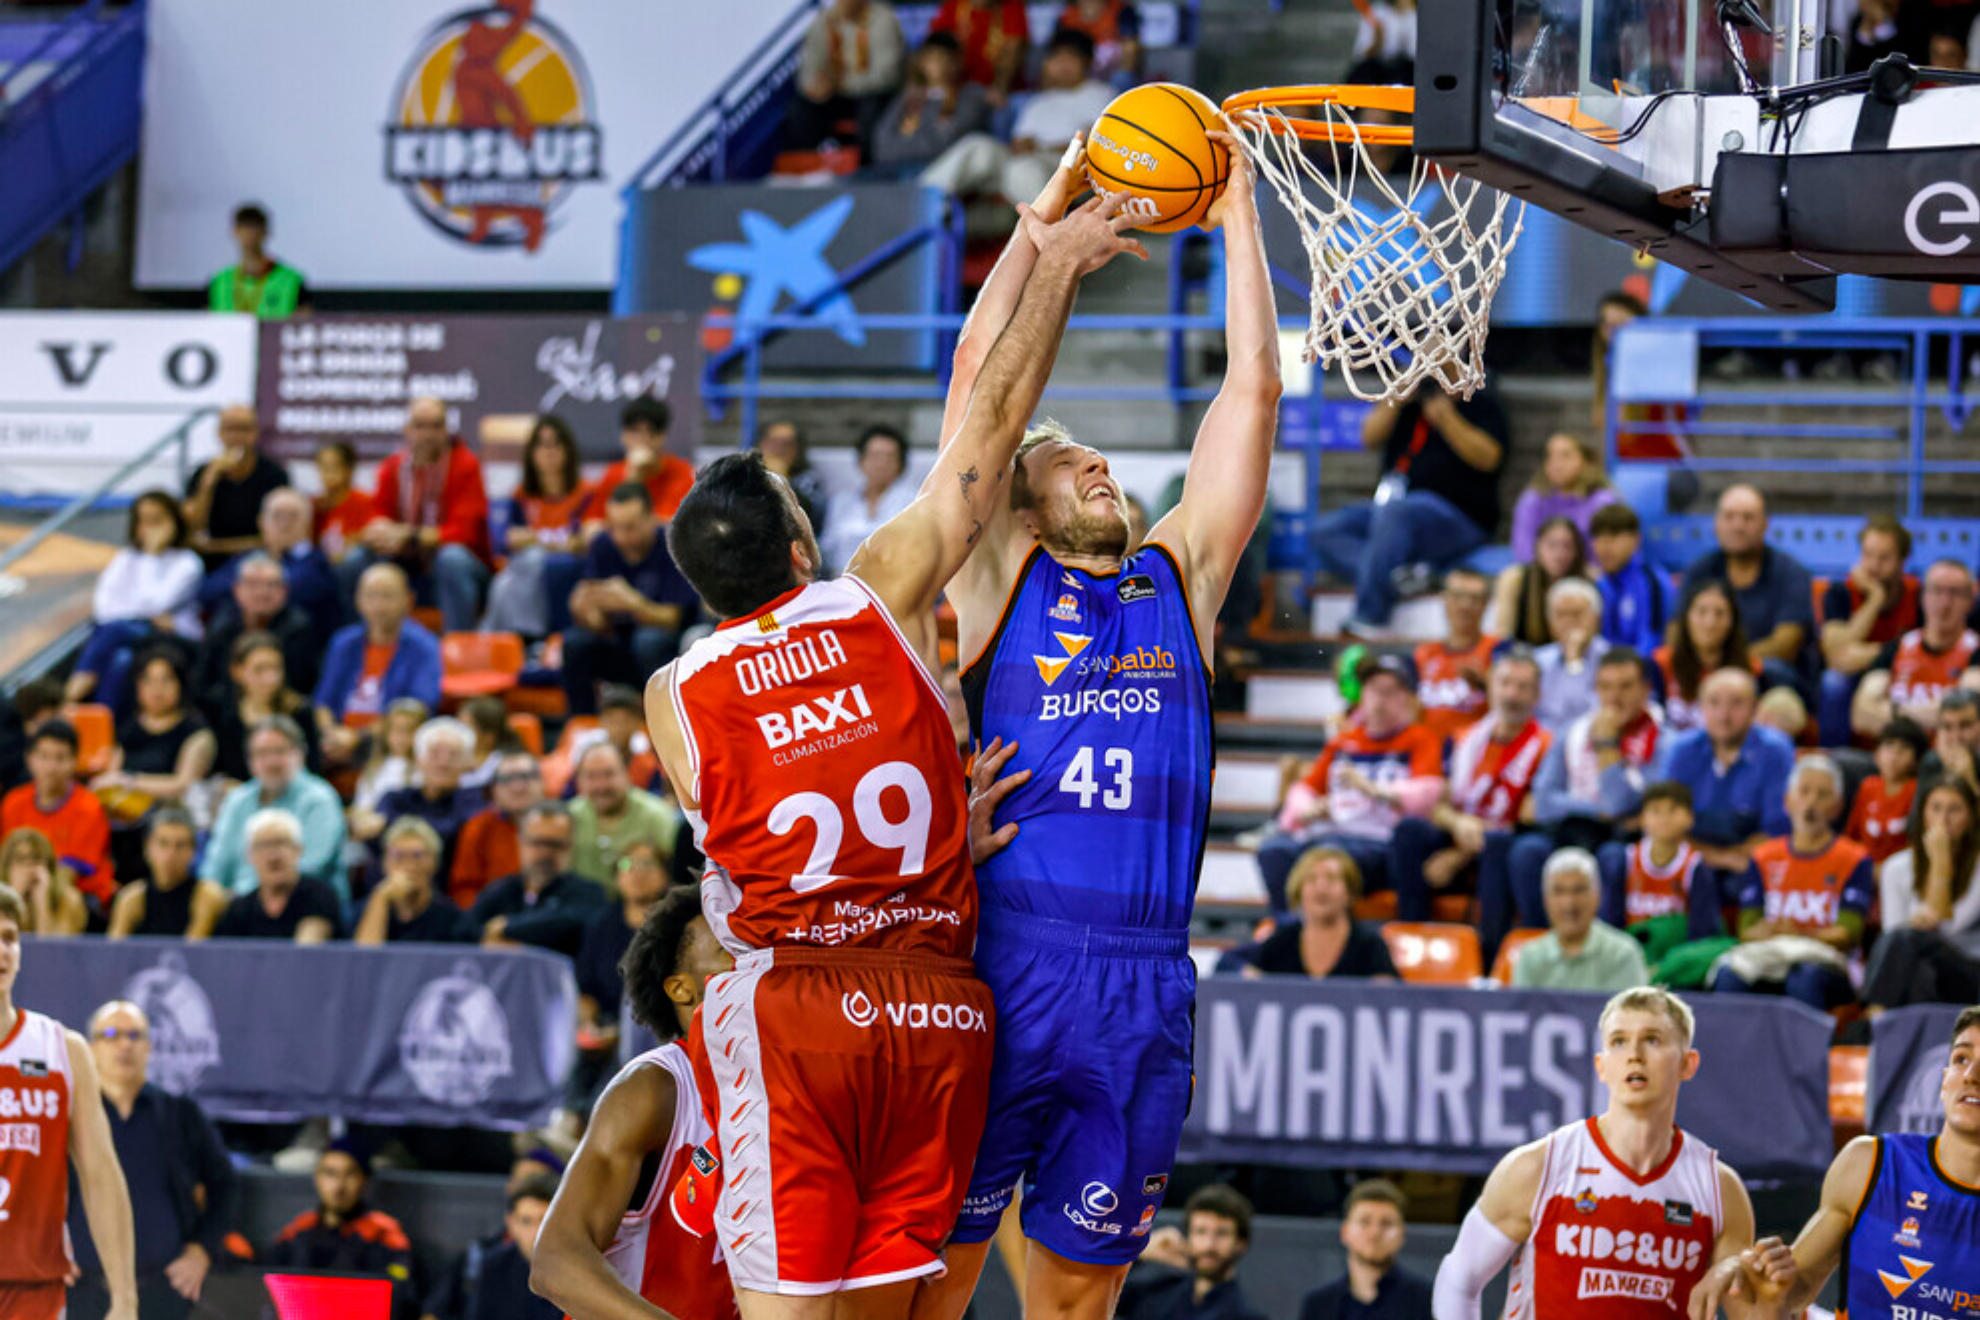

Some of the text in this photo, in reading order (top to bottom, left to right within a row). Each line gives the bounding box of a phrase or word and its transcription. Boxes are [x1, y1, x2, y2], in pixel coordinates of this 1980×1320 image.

[735, 629, 848, 696] ORIOLA
[756, 683, 874, 749] BAXI
[772, 720, 879, 767] CLIMATIZACIÓN
[1058, 746, 1134, 811] 43
[767, 761, 933, 894] 29
[1206, 1002, 1608, 1148] MANRES
[1063, 1203, 1123, 1235] LEXUS
[1555, 1223, 1702, 1271] KIDS&US
